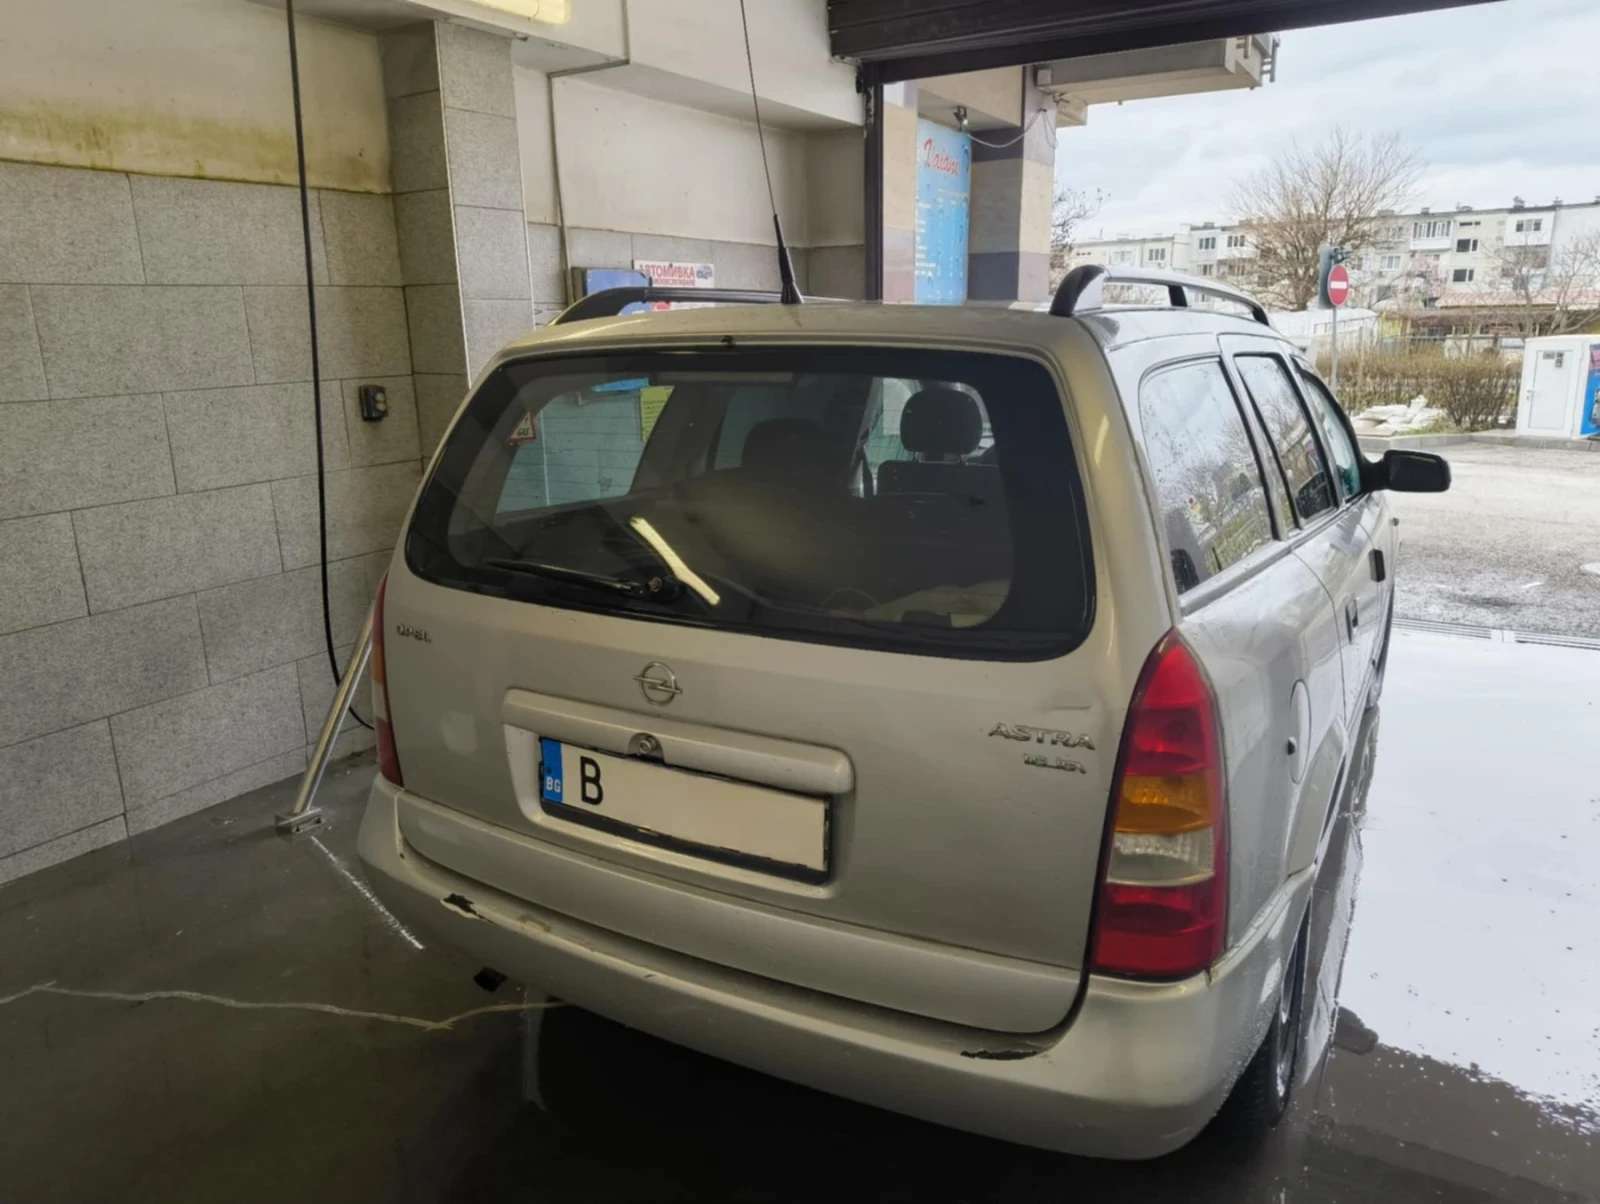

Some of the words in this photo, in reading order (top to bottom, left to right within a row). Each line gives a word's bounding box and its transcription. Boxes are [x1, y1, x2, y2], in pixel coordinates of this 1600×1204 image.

[396, 623, 431, 643] OPEL
[988, 723, 1095, 750] ASTRA
[546, 776, 561, 793] BG
[580, 755, 604, 806] B
